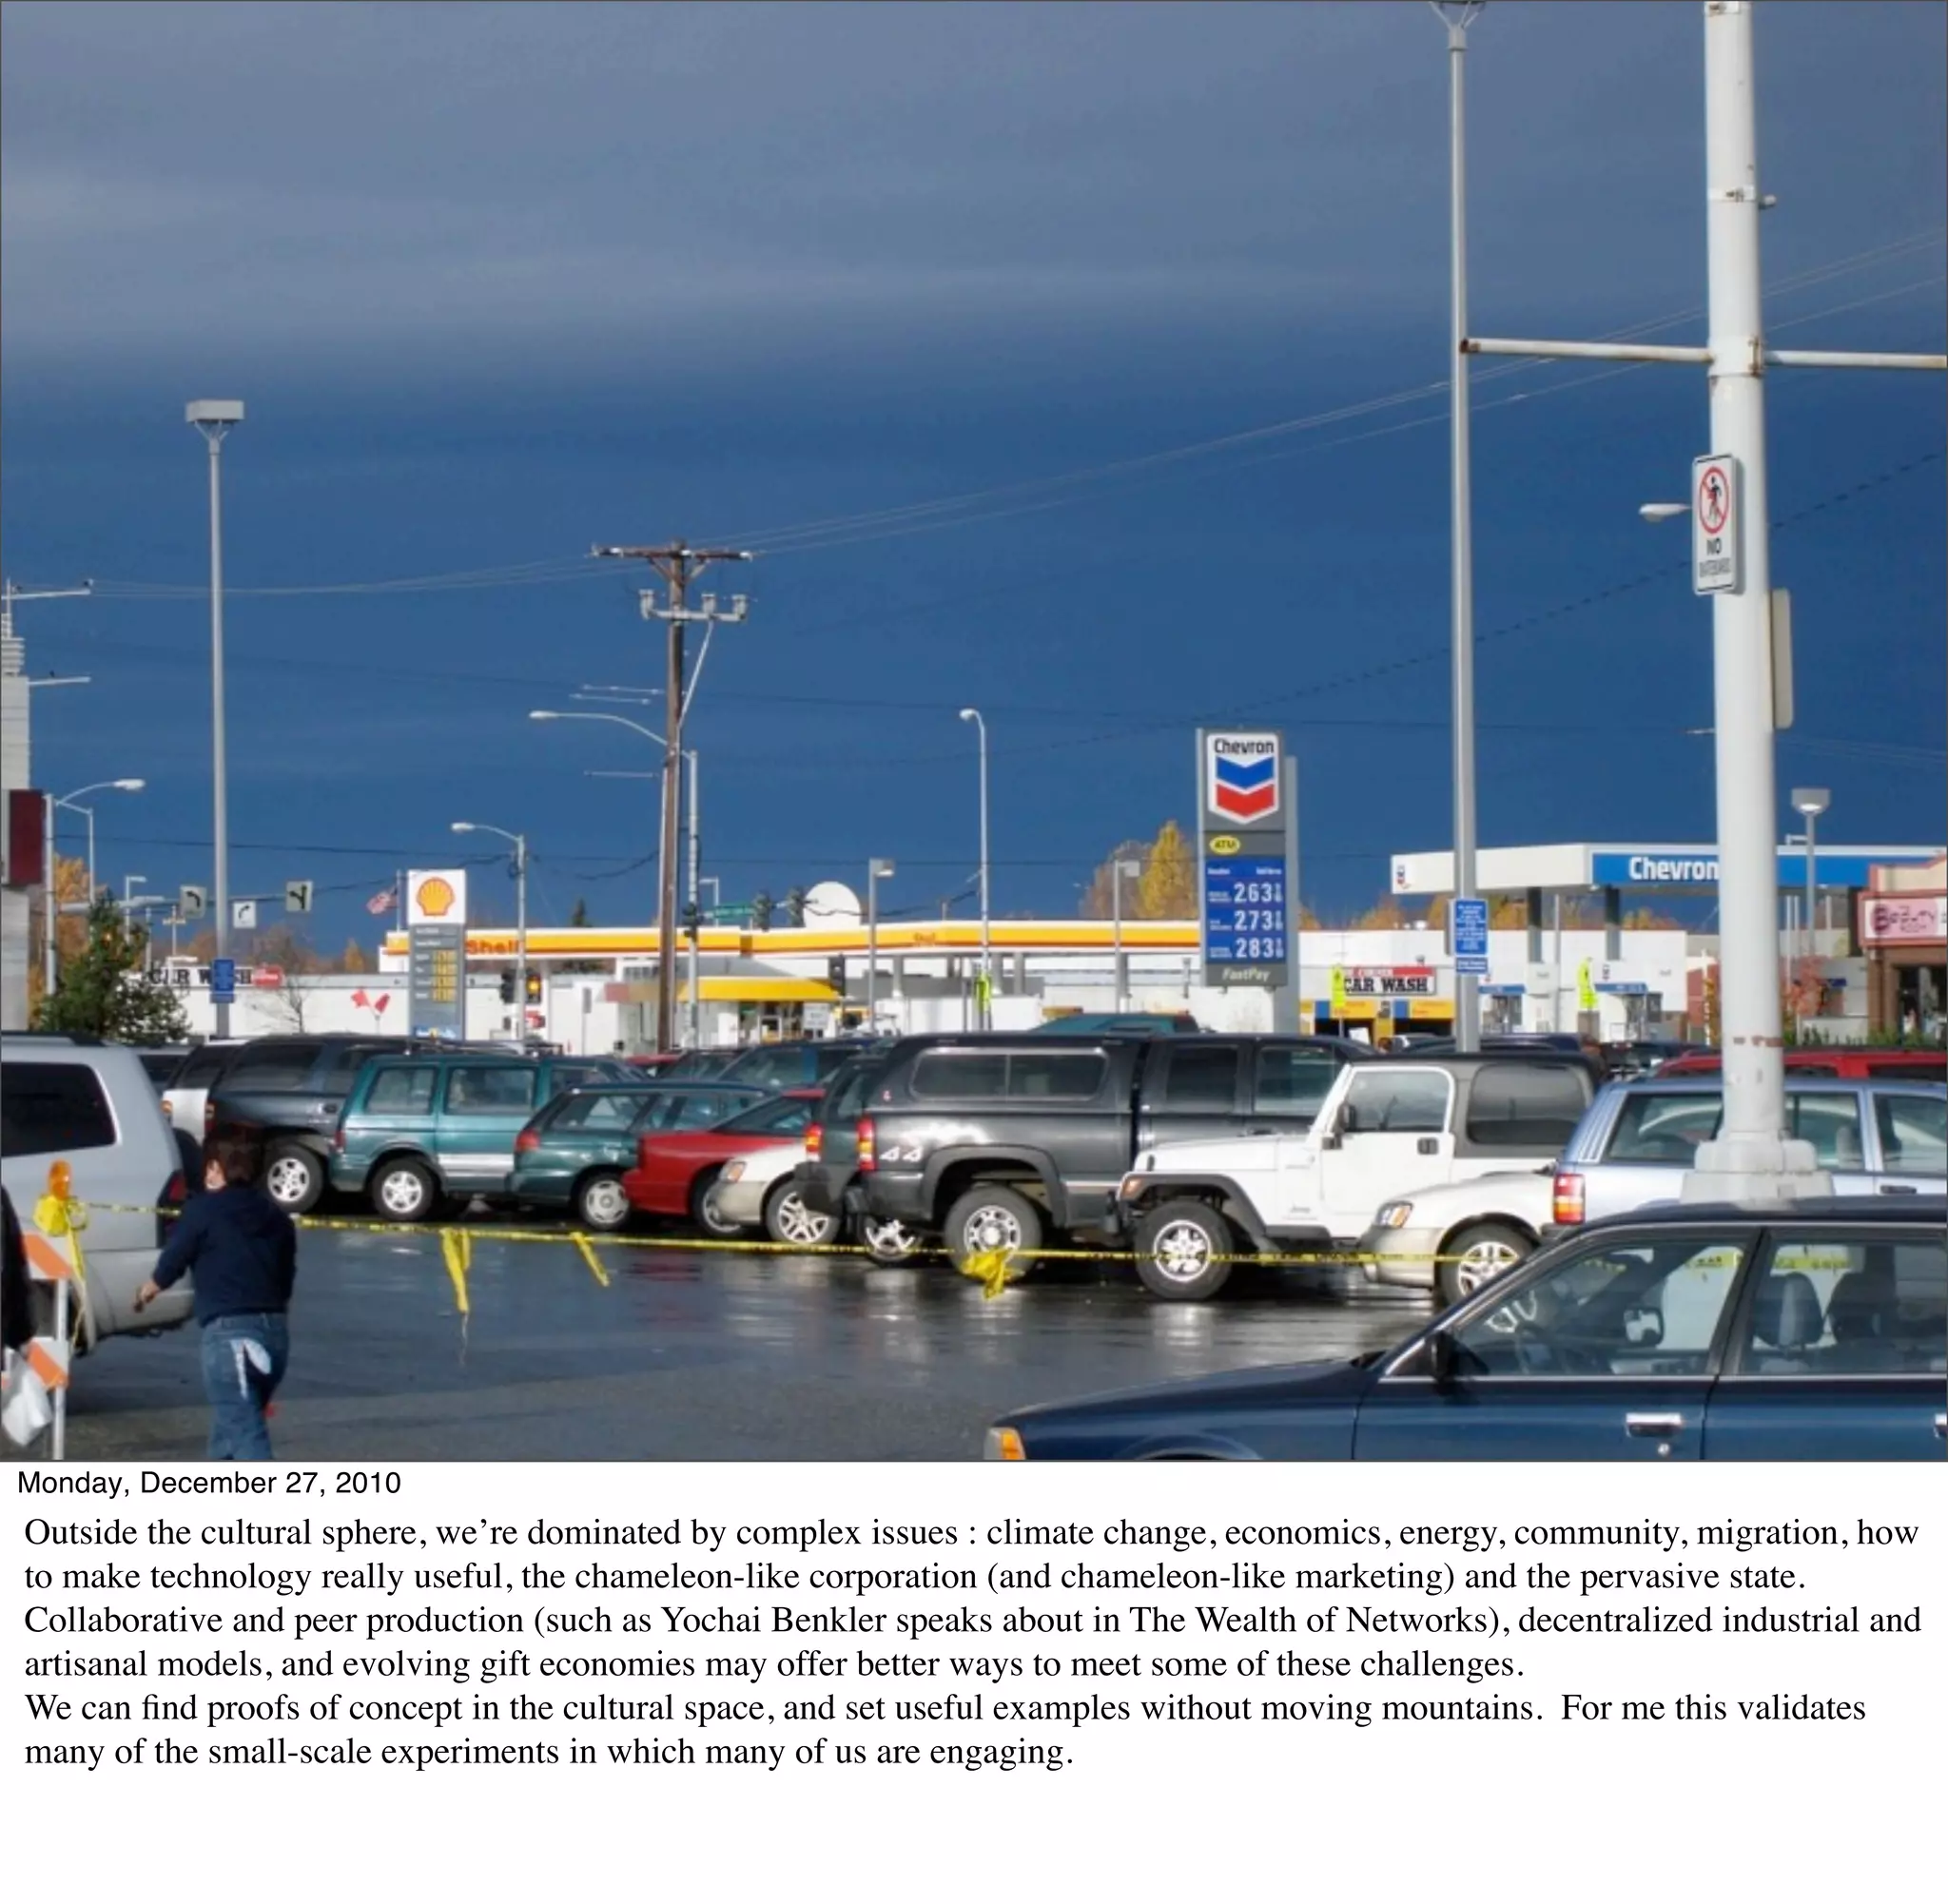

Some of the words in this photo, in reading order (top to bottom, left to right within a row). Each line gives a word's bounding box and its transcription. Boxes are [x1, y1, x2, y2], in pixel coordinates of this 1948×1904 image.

[1706, 536, 1723, 556] NO
[1214, 737, 1276, 755] Chevron
[1628, 855, 1720, 881] Chevron
[1221, 967, 1272, 982] FastPay
[1343, 976, 1375, 994] CAR
[1380, 976, 1430, 994] WASH
